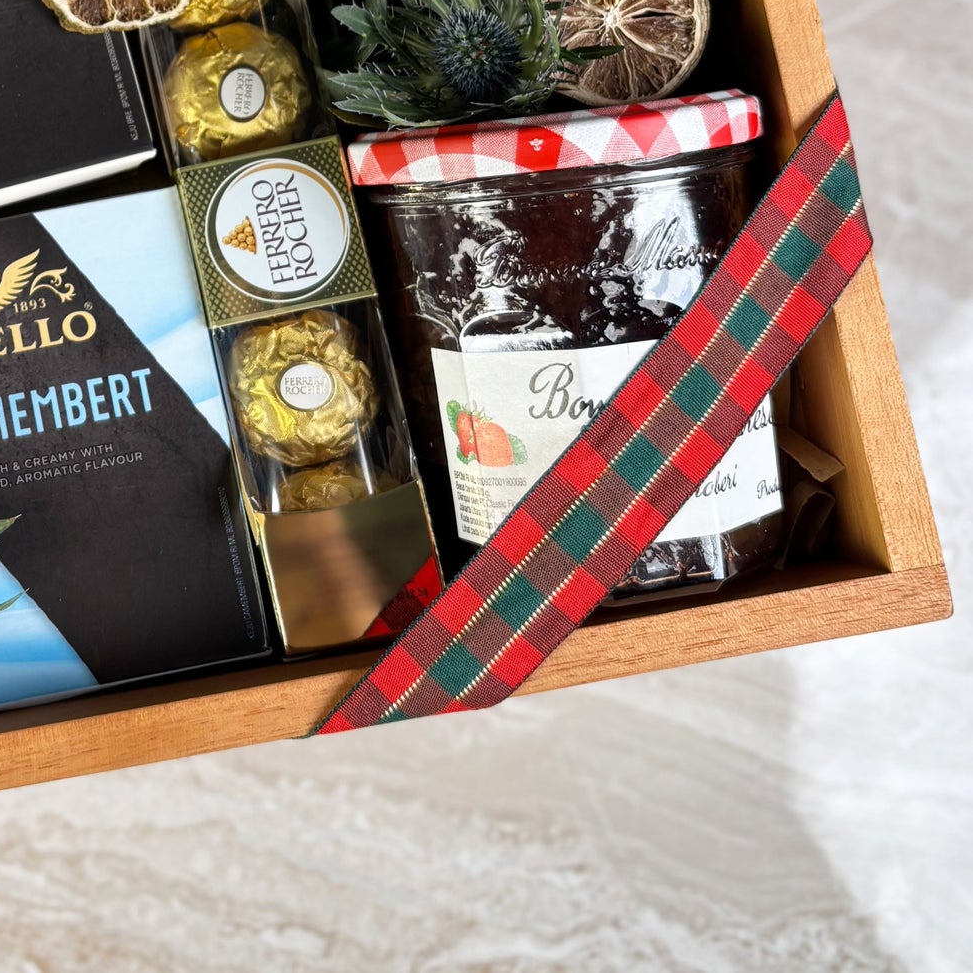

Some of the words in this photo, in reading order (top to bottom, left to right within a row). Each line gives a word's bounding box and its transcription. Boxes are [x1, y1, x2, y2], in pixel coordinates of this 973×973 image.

[251, 179, 295, 285] FERRERO
[275, 172, 318, 280] ROCHER
[12, 297, 47, 315] 1893
[12, 461, 21, 472] &
[24, 449, 76, 469] CREAMY
[80, 442, 114, 457] WITH
[16, 463, 81, 485] AROMATIC
[85, 451, 143, 473] FLAVOUR
